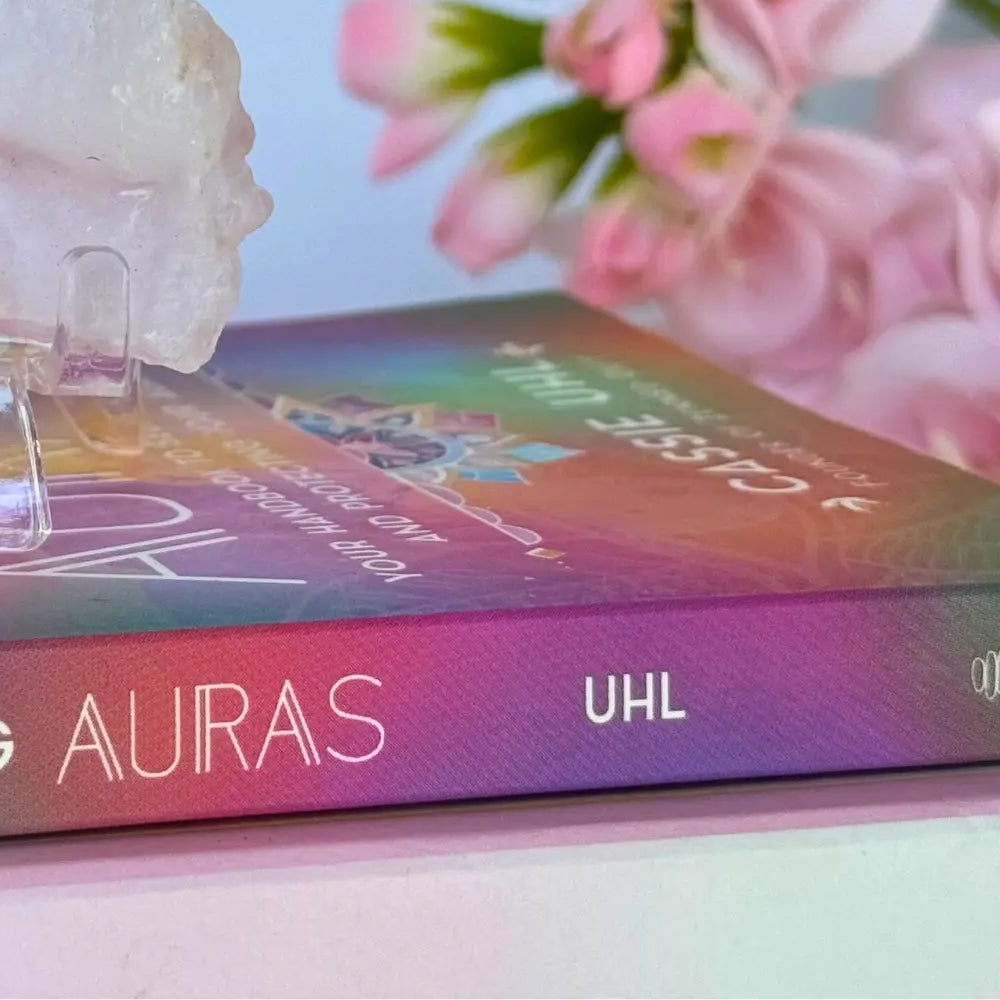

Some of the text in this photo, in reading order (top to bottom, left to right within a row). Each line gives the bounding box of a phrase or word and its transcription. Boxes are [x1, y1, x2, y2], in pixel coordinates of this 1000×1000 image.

[585, 413, 811, 493] CASSIE
[368, 515, 448, 543] AND
[329, 540, 423, 583] YOUR
[56, 674, 386, 785] AURAS
[584, 671, 687, 724] UHL
